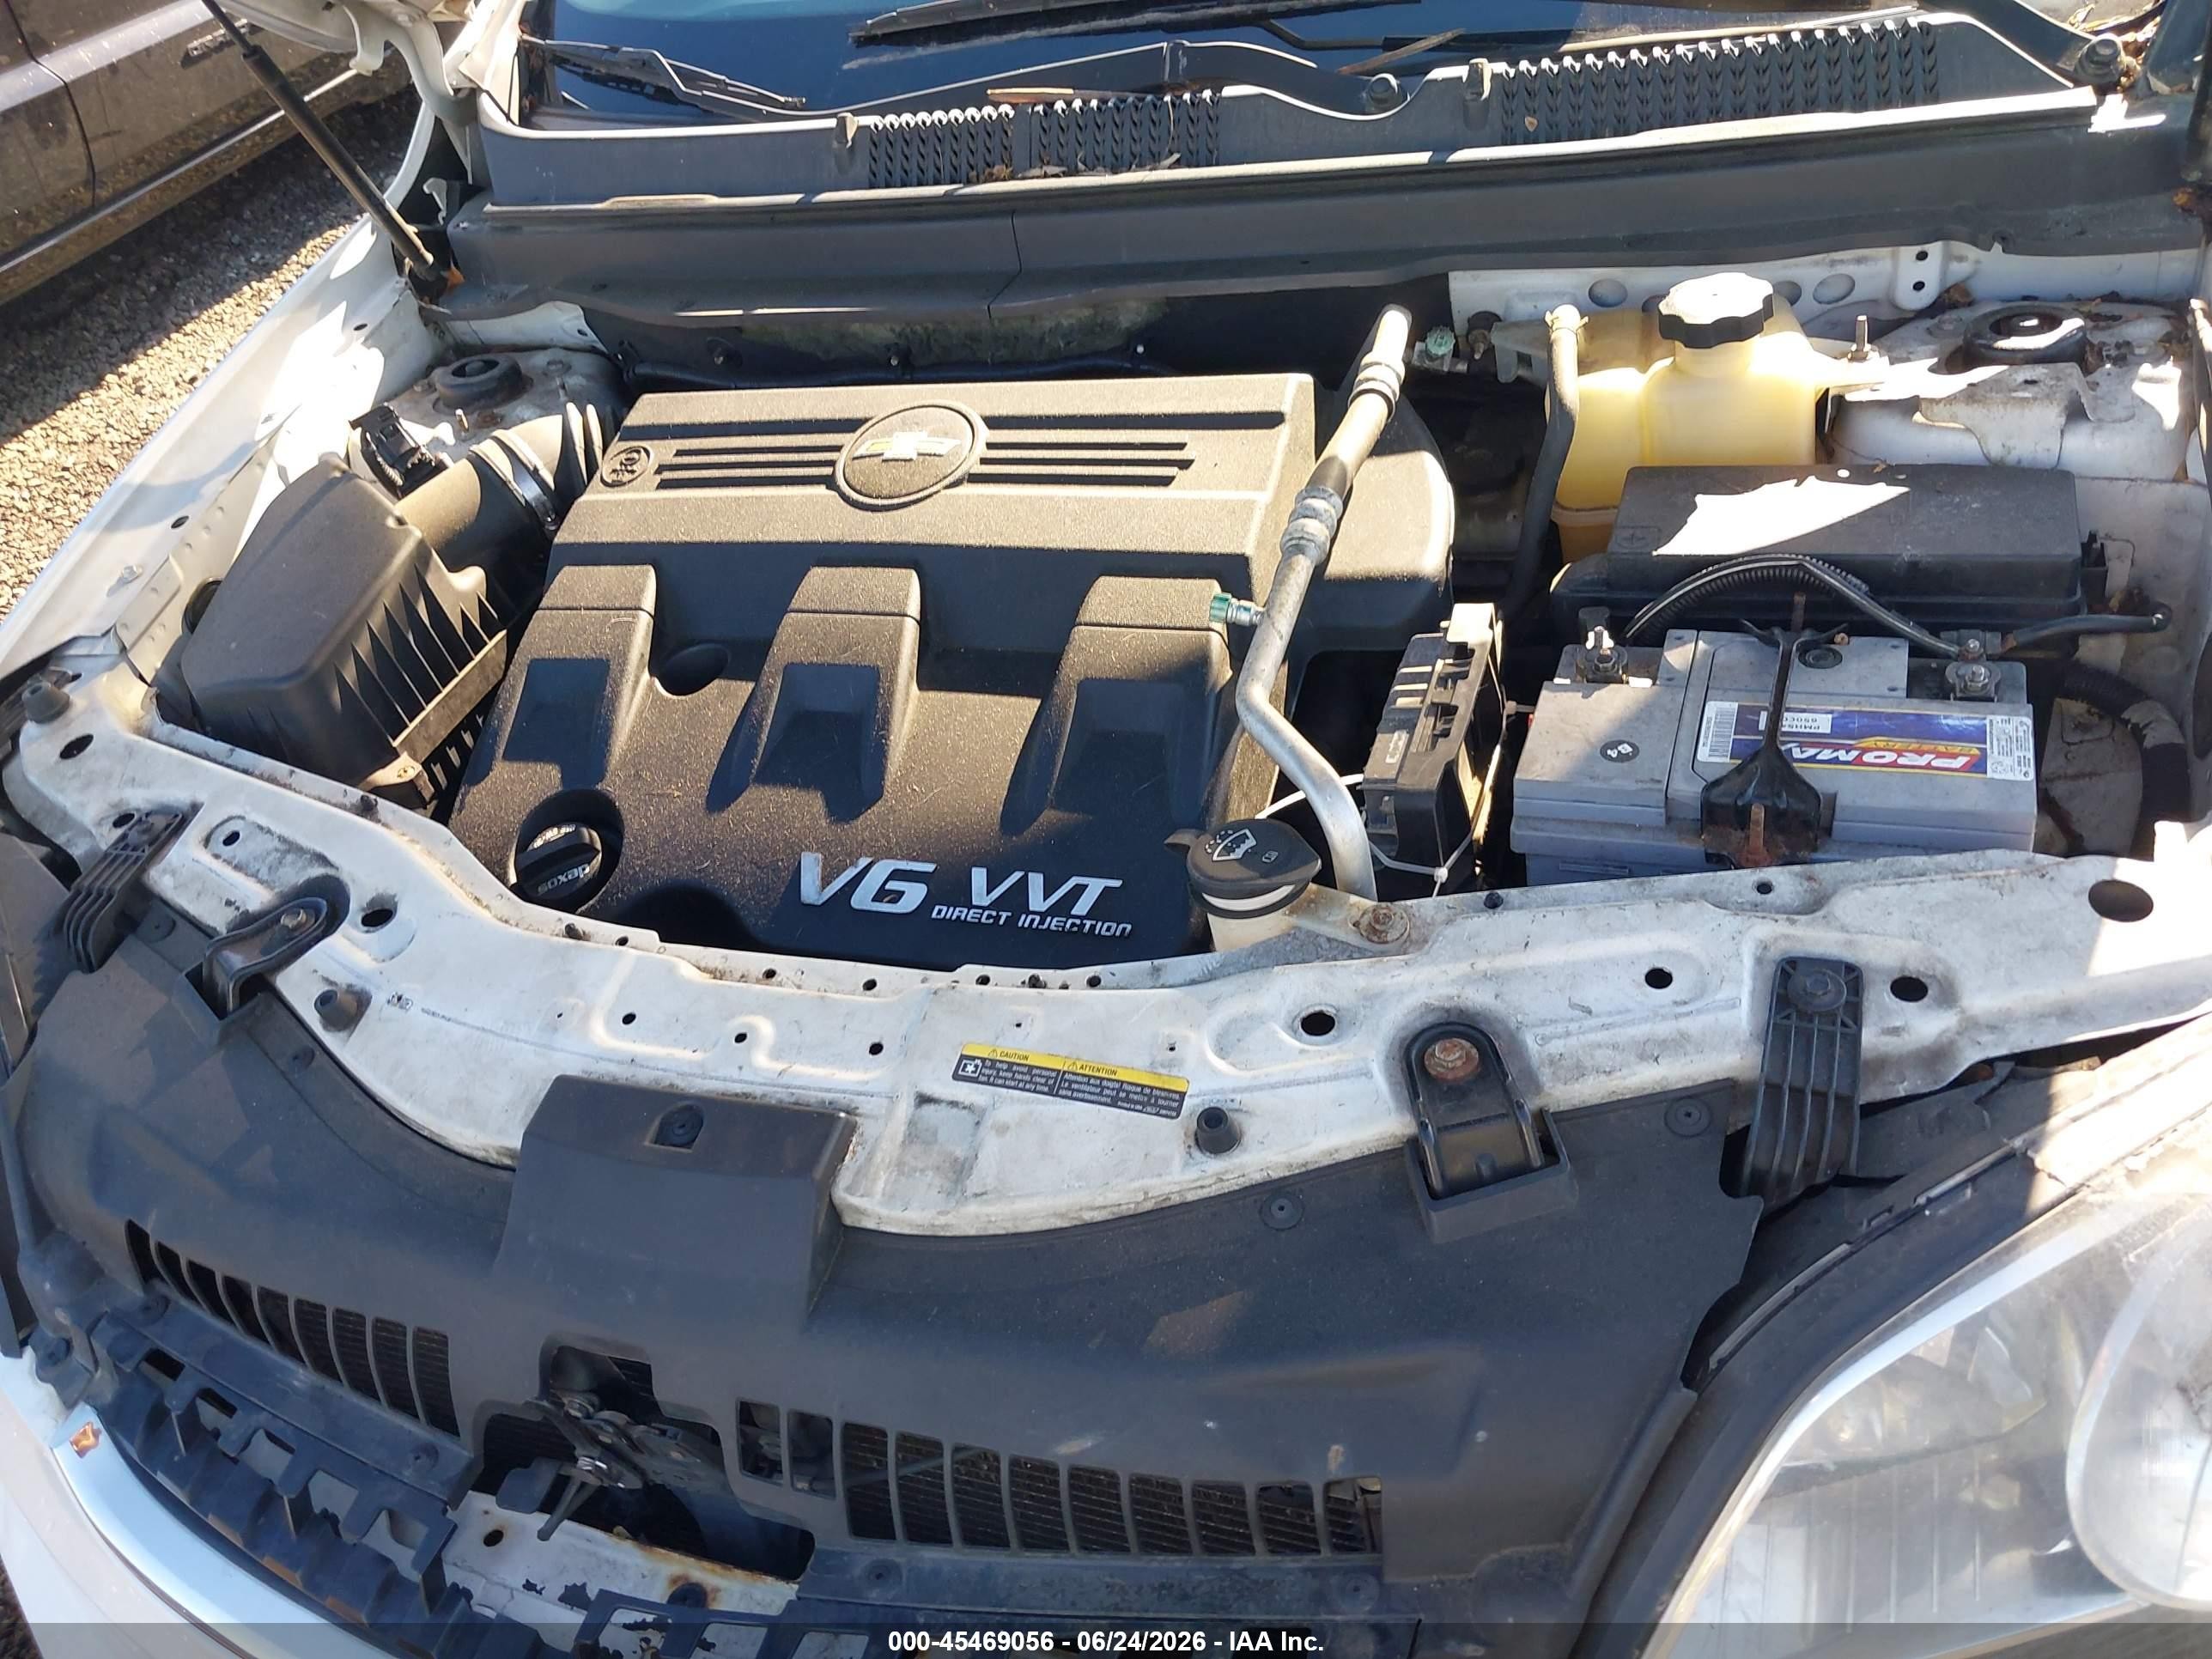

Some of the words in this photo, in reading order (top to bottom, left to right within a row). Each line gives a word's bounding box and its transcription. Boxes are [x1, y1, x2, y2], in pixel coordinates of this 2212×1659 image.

[538, 863, 590, 894] dexos
[800, 852, 937, 915] V6
[969, 866, 1123, 916] VVT
[931, 903, 1012, 927] DIRECT
[1017, 912, 1133, 937] INJECTION
[1000, 1050, 1030, 1062] CAUTION
[996, 1061, 1008, 1070] help
[1012, 1064, 1029, 1073] avoid
[1031, 1067, 1058, 1079] personal
[999, 1070, 1013, 1079] keep
[1014, 1072, 1031, 1082] hands
[1032, 1074, 1047, 1084] clear
[1079, 1064, 1118, 1077] ATTENTION
[1005, 1078, 1018, 1087] start
[1064, 1073, 1089, 1084] Attention
[1089, 1076, 1100, 1085] aux
[1103, 1087, 1116, 1097] peut
[1158, 1096, 1180, 1108] tourner
